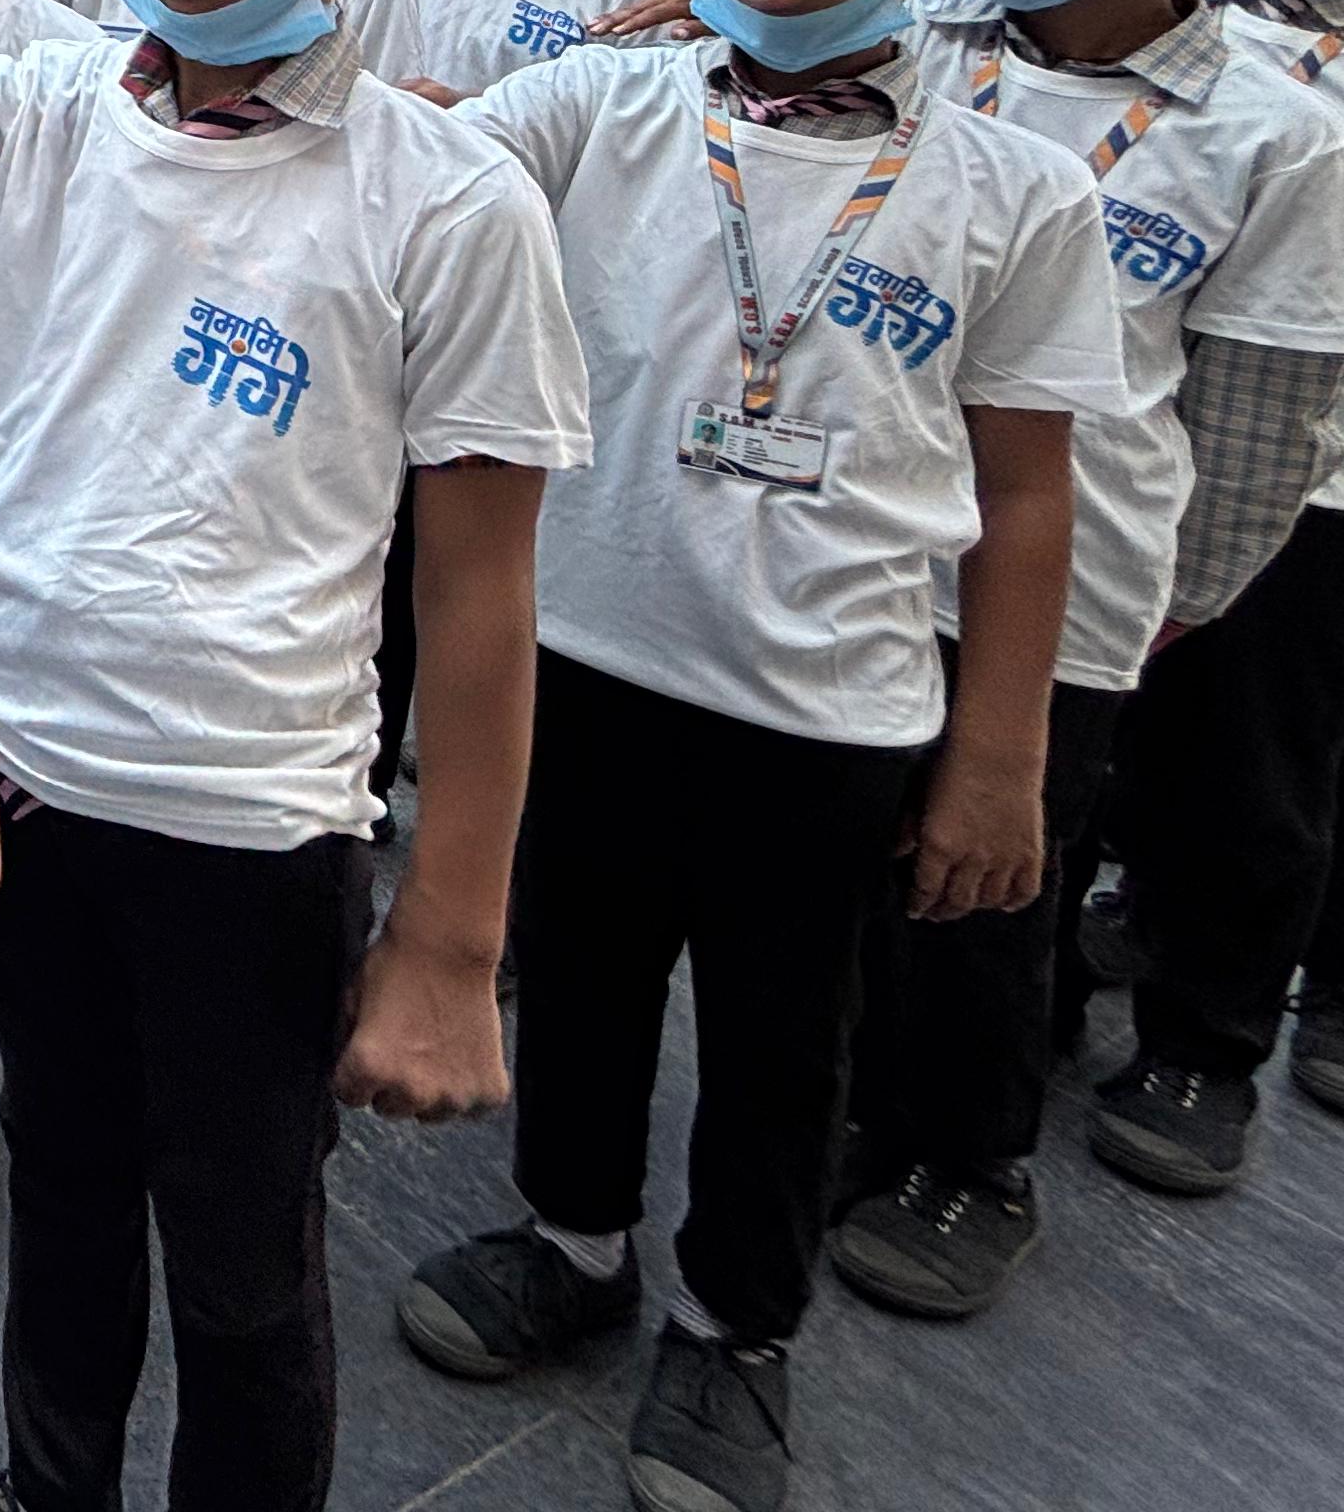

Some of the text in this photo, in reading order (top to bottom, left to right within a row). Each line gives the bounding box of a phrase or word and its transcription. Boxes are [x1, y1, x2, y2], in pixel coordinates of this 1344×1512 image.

[843, 254, 936, 316] नमामि
[189, 296, 288, 367] नमामि
[171, 324, 311, 437] गंगे
